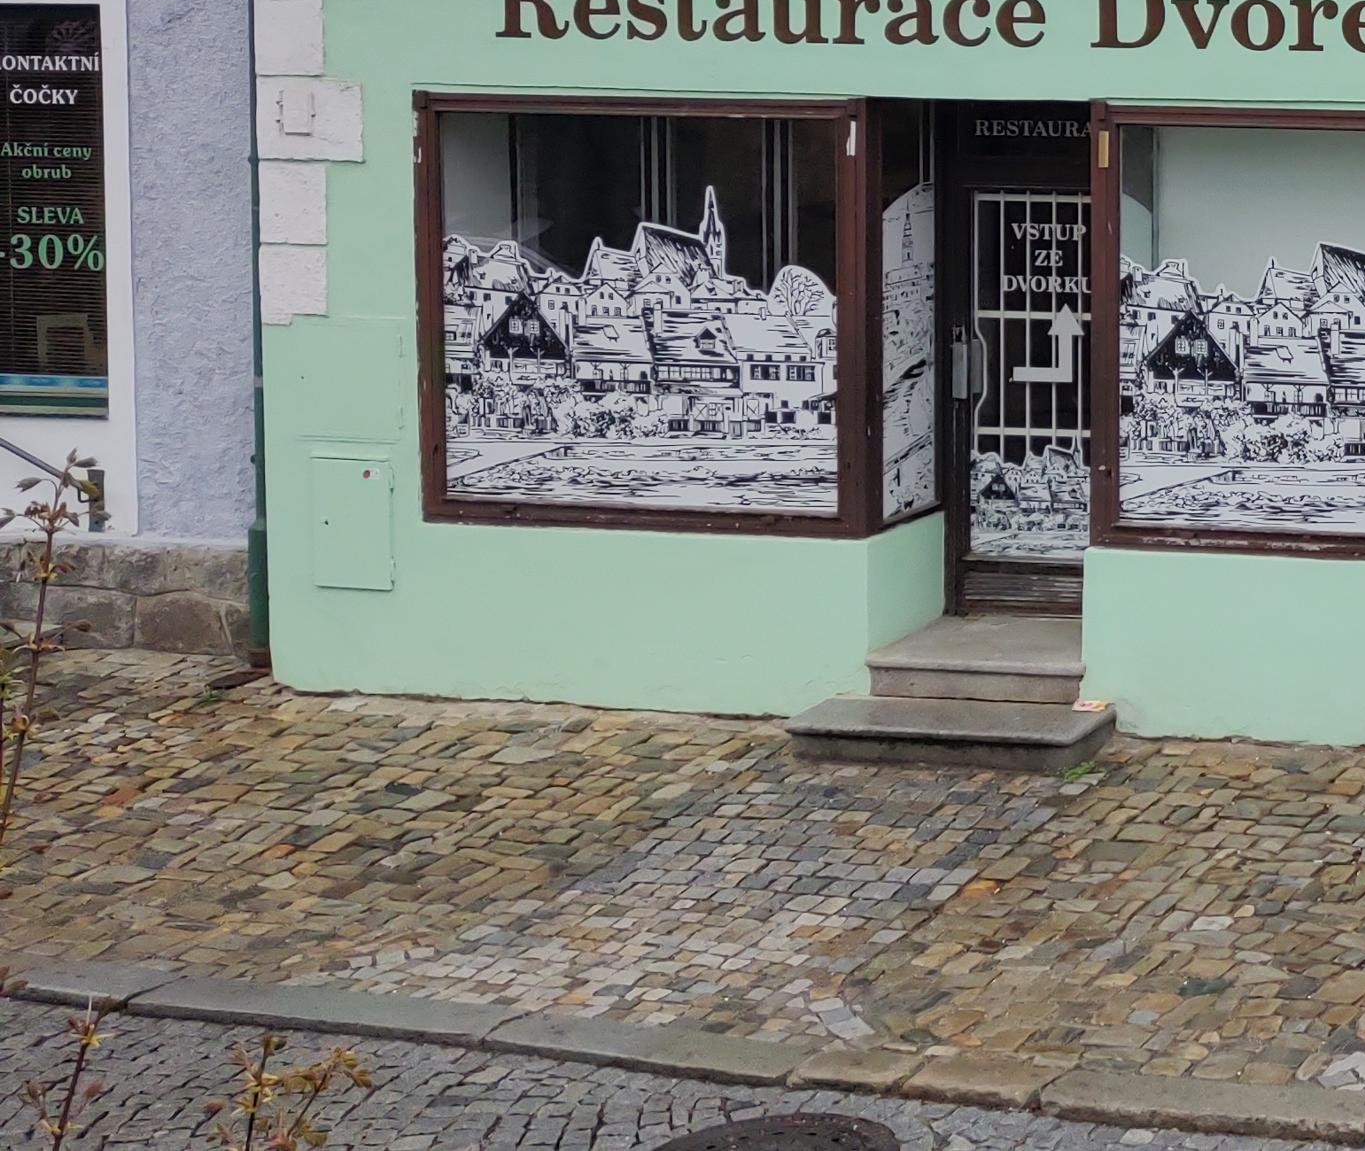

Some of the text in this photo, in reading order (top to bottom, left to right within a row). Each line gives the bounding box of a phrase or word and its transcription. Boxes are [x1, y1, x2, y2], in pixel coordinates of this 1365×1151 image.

[0, 51, 100, 72] ONTAKTNÍ
[9, 84, 79, 105] ČOČKY
[975, 119, 1091, 137] RESTAURA
[0, 143, 92, 160] Akční ceny
[22, 164, 72, 179] obrub
[17, 207, 85, 225] SLEVA
[1011, 223, 1087, 241] VSTUP
[0, 234, 104, 271] -30%
[1034, 250, 1063, 267] ZE
[1002, 275, 1092, 294] DVORKU
